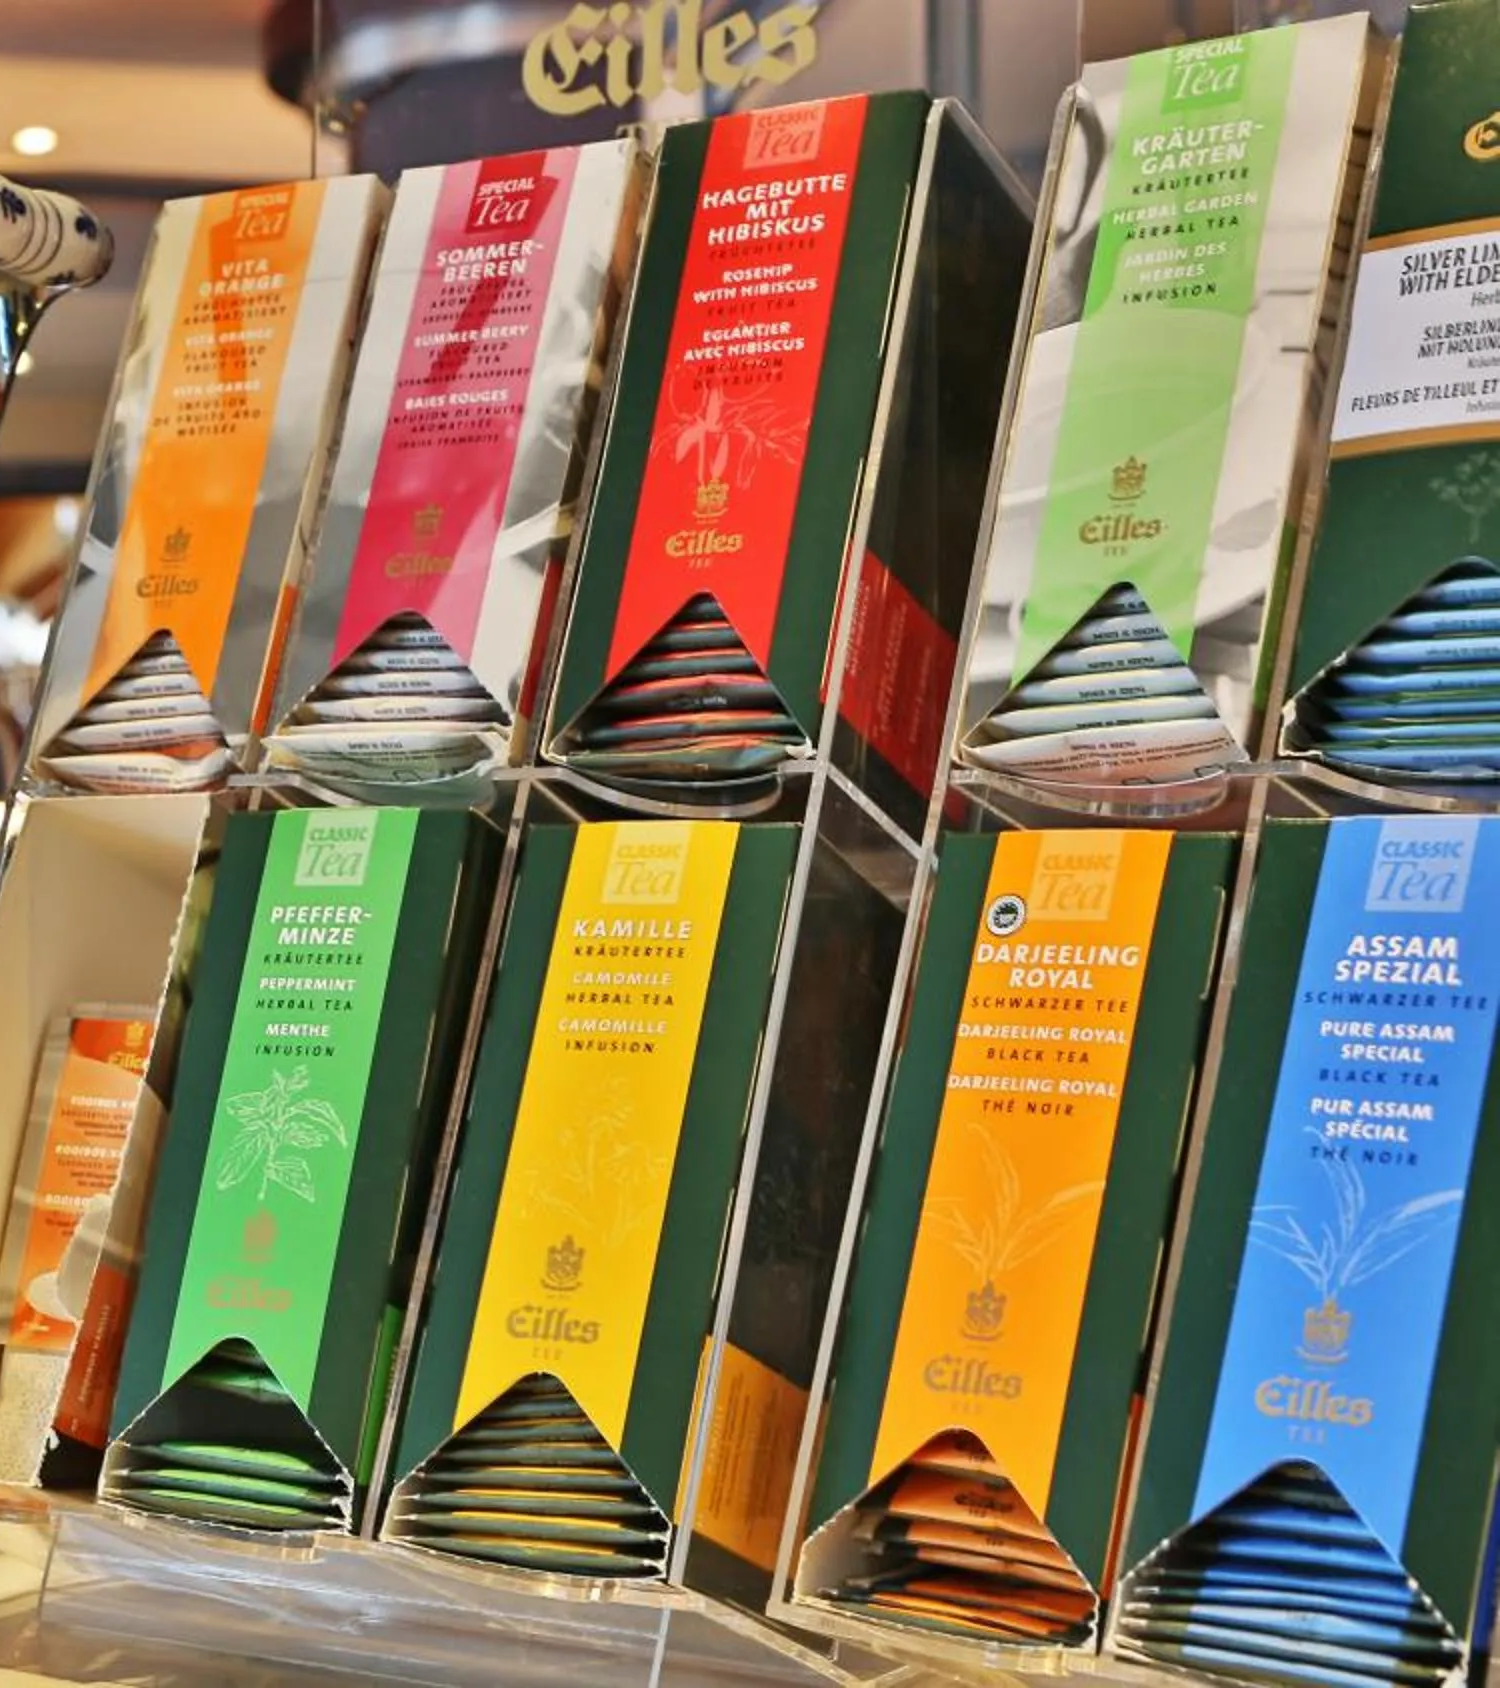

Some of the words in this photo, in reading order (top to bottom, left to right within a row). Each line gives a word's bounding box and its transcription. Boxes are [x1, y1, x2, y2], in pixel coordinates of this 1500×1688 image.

[522, 0, 819, 115] Eilles
[1175, 38, 1244, 63] SPECIAL
[1173, 61, 1239, 100] Tea
[756, 128, 815, 161] Tea
[1133, 120, 1265, 156] KRÄUTER-
[477, 176, 536, 197] SPECIAL
[702, 173, 848, 209] HAGEBUTTE
[472, 195, 530, 227] Tea
[745, 199, 795, 221] MIT
[1112, 202, 1178, 225] HERBAL
[1184, 192, 1259, 214] GARDEN
[707, 213, 827, 246] HIBISKUS
[1126, 222, 1195, 240] HERBAL
[1207, 215, 1239, 230] TEA
[436, 239, 545, 267] SOMMER-
[1124, 247, 1188, 268] JARDIN
[1194, 242, 1228, 258] DES
[1401, 246, 1467, 276] SILVER
[221, 258, 269, 278] VITA
[443, 258, 528, 283] BEEREN
[722, 263, 794, 284] ROSEHIP
[1139, 262, 1206, 283] HERBES
[199, 273, 286, 297] ORANGE
[693, 287, 737, 305] WITH
[740, 277, 819, 297] HIBISCUS
[1123, 282, 1217, 304] INFUSION
[1399, 270, 1450, 296] WITH
[414, 329, 479, 347] SUMMER
[481, 324, 529, 340] BERRY
[683, 345, 724, 362] AVEC
[727, 337, 805, 357] HIBISCUS
[405, 393, 447, 411] BAIES
[449, 388, 510, 406] ROUGES
[1351, 391, 1400, 413] FLEURS
[1402, 387, 1421, 405] DE
[1424, 380, 1478, 402] TILLEUL
[1481, 377, 1499, 396] ET
[1078, 512, 1162, 545] Eilles
[664, 527, 744, 558] Eilles
[136, 574, 199, 598] Eilles
[309, 826, 368, 842] CLASSIC
[303, 843, 363, 878] Tea
[1381, 840, 1464, 859] CLASSIC
[612, 861, 676, 896] Tea
[1376, 860, 1457, 902] Tea
[1036, 872, 1108, 911] Tea
[270, 905, 373, 924] PFEFFER-
[278, 926, 357, 945] MINZE
[573, 919, 693, 939] KAMILLE
[263, 951, 364, 965] KRÄUTERTEE
[574, 943, 686, 959] KRÄUTERTEE
[976, 943, 1142, 967] DARJEELING
[1347, 934, 1459, 960] ASSAM
[259, 976, 357, 991] PEPPERMINT
[573, 971, 674, 986] CAMOMILE
[1008, 968, 1094, 989] ROYAL
[1334, 959, 1464, 987] SPEZIAL
[256, 999, 315, 1010] HERBAL
[325, 999, 354, 1011] TEA
[565, 991, 631, 1004] HERBAL
[643, 993, 674, 1006] TEA
[971, 995, 1085, 1012] SCHWARZER
[1096, 999, 1130, 1013] TEE
[1304, 991, 1436, 1008] SCHWARZER
[1451, 995, 1489, 1011] TEE
[265, 1022, 331, 1037] MENTHE
[558, 1017, 668, 1034] CAMOMILLE
[957, 1022, 1064, 1041] DARJEELING
[1068, 1027, 1127, 1045] ROYAL
[1319, 1020, 1377, 1038] PURE
[1379, 1023, 1456, 1043] ASSAM
[255, 1044, 335, 1057] INFUSION
[565, 1039, 655, 1053] INFUSION
[986, 1047, 1045, 1062] BLACK
[1056, 1050, 1090, 1063] TEA
[1340, 1042, 1426, 1064] SPECIAL
[947, 1073, 1054, 1093] DARJEELING
[1058, 1078, 1117, 1098] ROYAL
[1319, 1068, 1388, 1084] BLACK
[1401, 1071, 1440, 1087] TEA
[1027, 1101, 1075, 1116] NOIR
[1310, 1096, 1354, 1116] PUR
[1358, 1099, 1434, 1121] ASSAM
[1324, 1118, 1410, 1143] SPÉCIAL
[1362, 1149, 1419, 1167] NOIR
[506, 1303, 600, 1345] Eilles
[924, 1353, 1024, 1399] Eilles
[1254, 1375, 1375, 1428] Eilles
